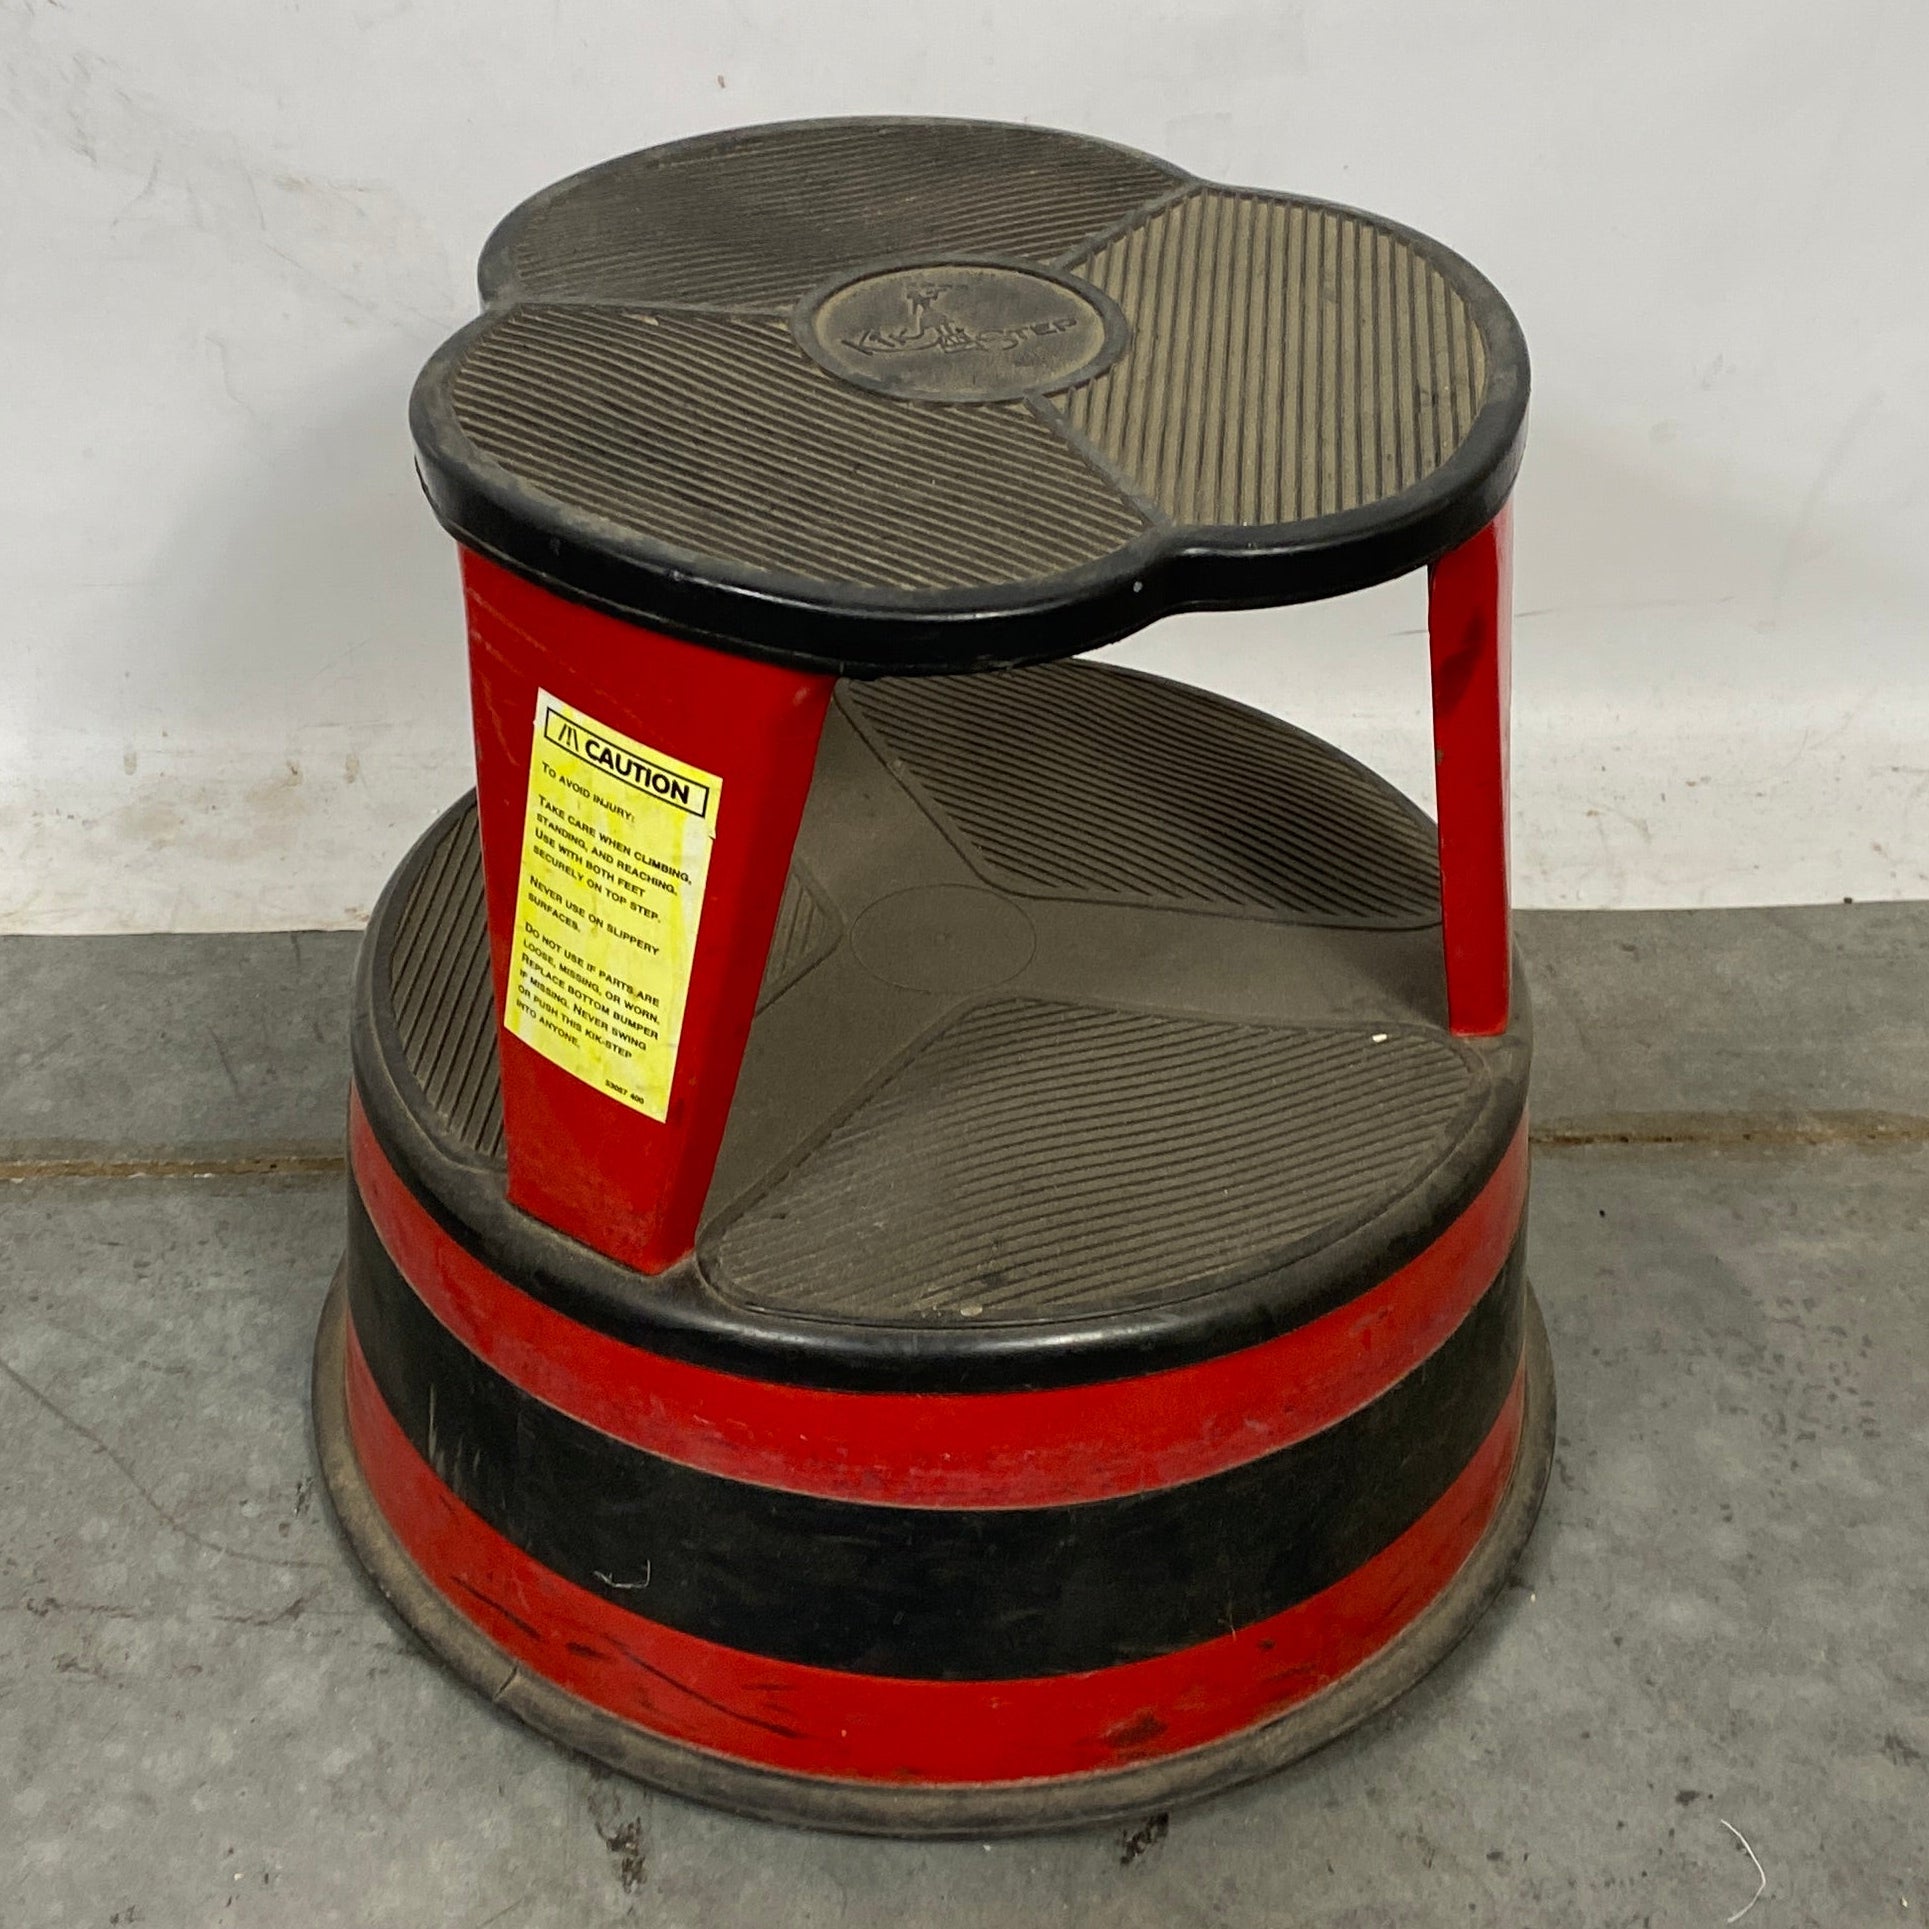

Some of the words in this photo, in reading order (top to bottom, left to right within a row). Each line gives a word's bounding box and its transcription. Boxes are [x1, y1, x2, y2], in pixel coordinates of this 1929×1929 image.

[542, 761, 556, 778] TO
[559, 775, 590, 798] AVOID
[584, 738, 690, 805] CAUTION
[539, 794, 565, 820] TAKE
[567, 815, 596, 838] CARE
[599, 832, 631, 856] WHEN
[591, 846, 614, 864] AND
[533, 845, 584, 881] SECURELY
[586, 879, 602, 893] ON
[605, 888, 627, 904] TOP
[630, 901, 660, 923] STEP.
[535, 827, 555, 848] USE
[558, 843, 583, 865] WITH
[585, 860, 614, 883] BOTH
[617, 877, 646, 897] FEET
[530, 875, 563, 904] NEVER
[565, 900, 585, 918] USE
[588, 913, 604, 928] ON
[607, 923, 660, 955] SLIPPERY
[521, 952, 565, 989] REPLACE
[567, 985, 610, 1016] BOTTOM
[613, 1011, 658, 1040] BUMPER
[525, 921, 540, 939] DO
[542, 935, 562, 953] NOT
[564, 949, 584, 968] USE
[586, 963, 596, 973] IF
[598, 970, 634, 995] PARTS
[635, 991, 659, 1008] ARE
[516, 999, 537, 1019] INTO
[518, 984, 531, 999] OR
[533, 995, 558, 1017] PUSH
[561, 1013, 582, 1032] THIS
[520, 969, 528, 978] IF
[573, 1003, 608, 1032] NEVER
[612, 1027, 646, 1051] SWING
[605, 990, 621, 1005] OR
[624, 1000, 660, 1025] WORN.
